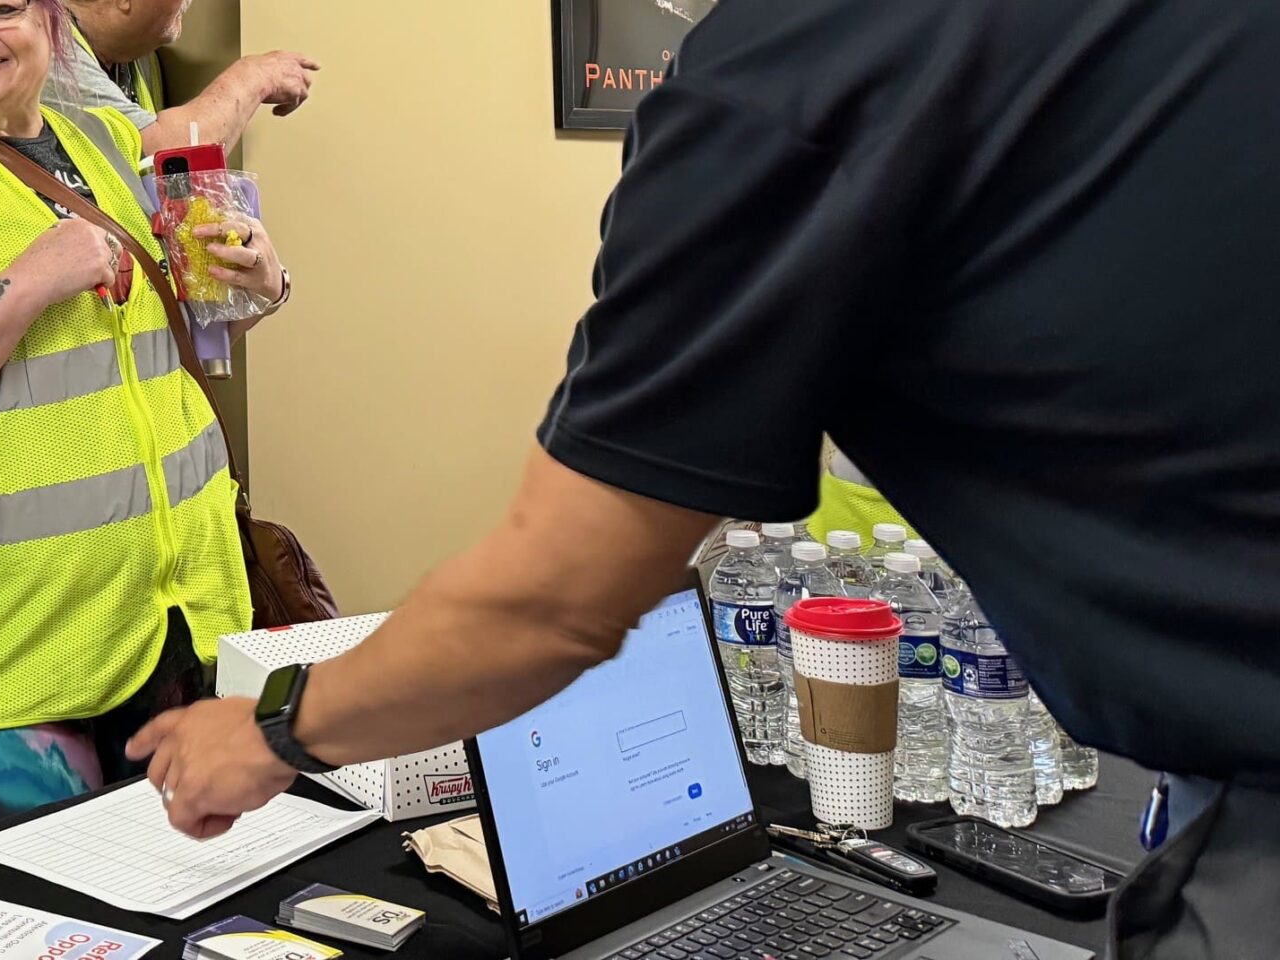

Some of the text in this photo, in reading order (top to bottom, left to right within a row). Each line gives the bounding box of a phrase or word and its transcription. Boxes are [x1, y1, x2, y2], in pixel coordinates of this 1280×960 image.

[741, 608, 770, 620] Pure
[746, 620, 768, 634] Life
[536, 755, 560, 772] Sign in
[431, 777, 464, 797] Krispy
